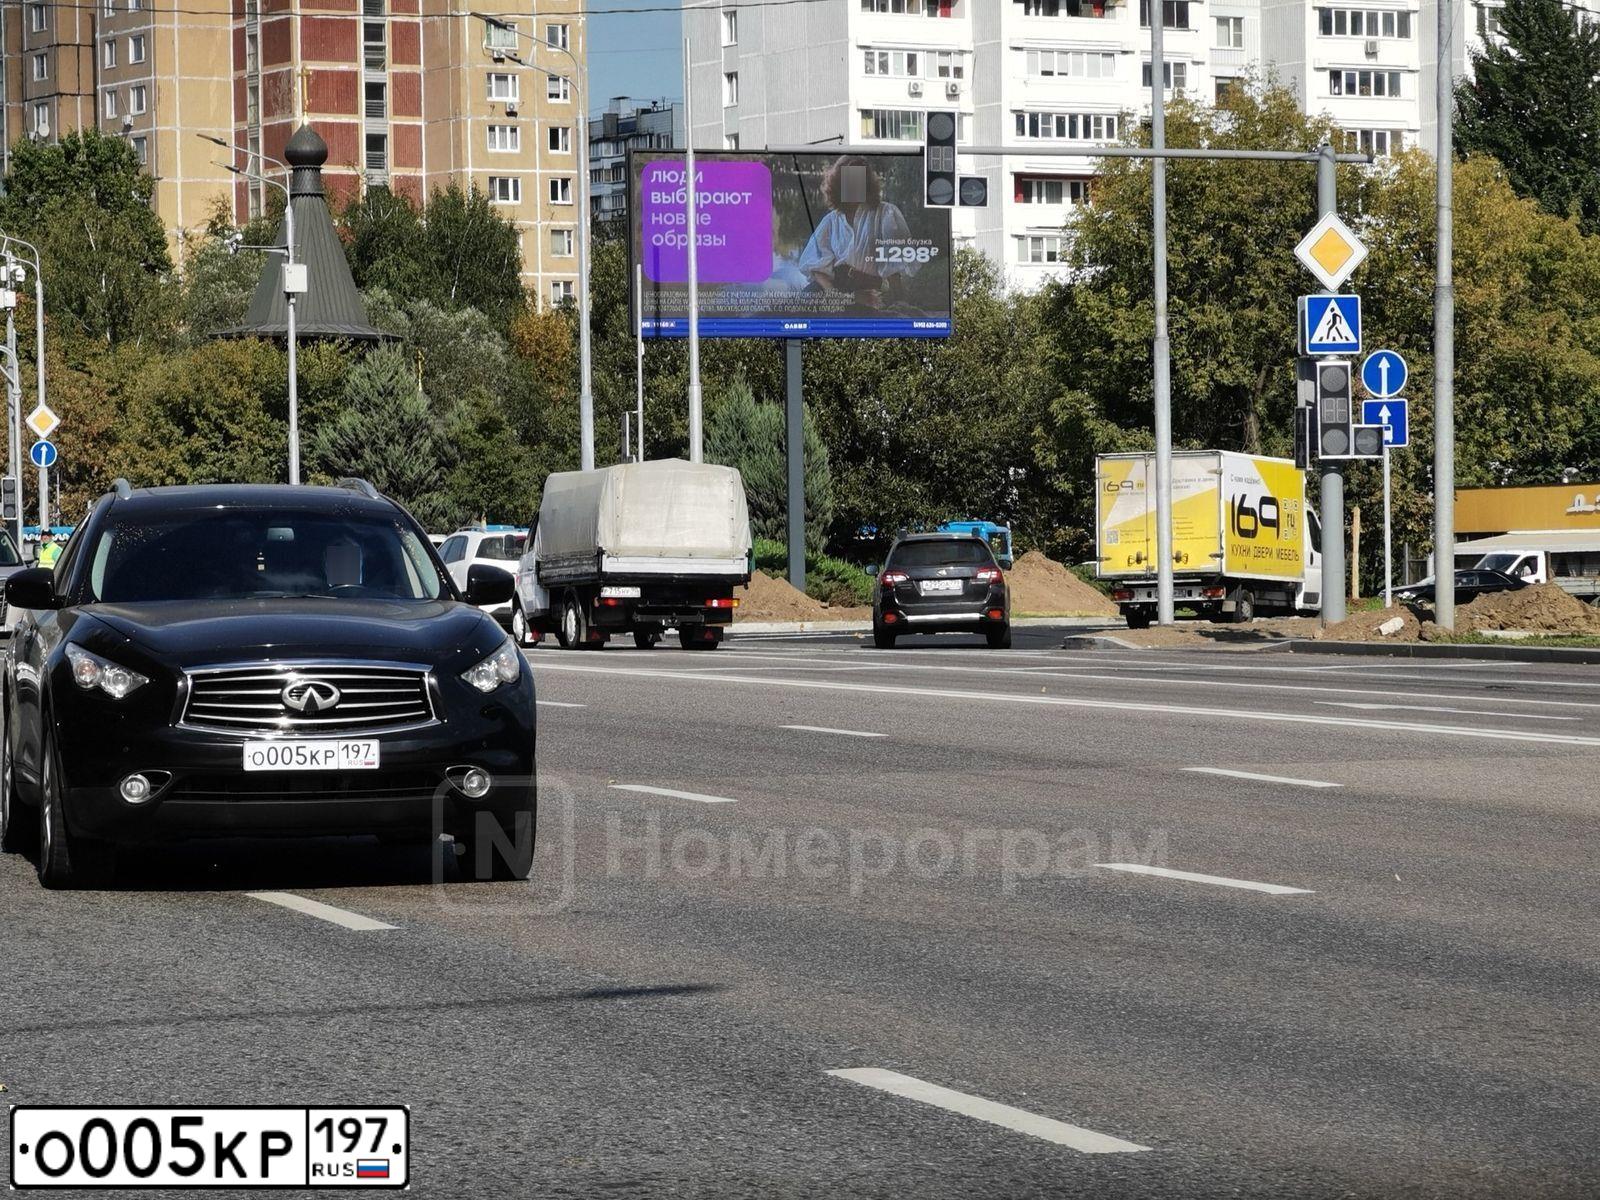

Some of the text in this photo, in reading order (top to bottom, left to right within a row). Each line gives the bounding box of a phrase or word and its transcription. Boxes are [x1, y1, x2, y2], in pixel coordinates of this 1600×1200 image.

[907, 238, 932, 247] блузка
[1231, 493, 1280, 540] 169
[1230, 543, 1300, 562] КУХНИ ДВЕРИ МЕБЕЛЬ
[252, 743, 372, 766] О005КР 197
